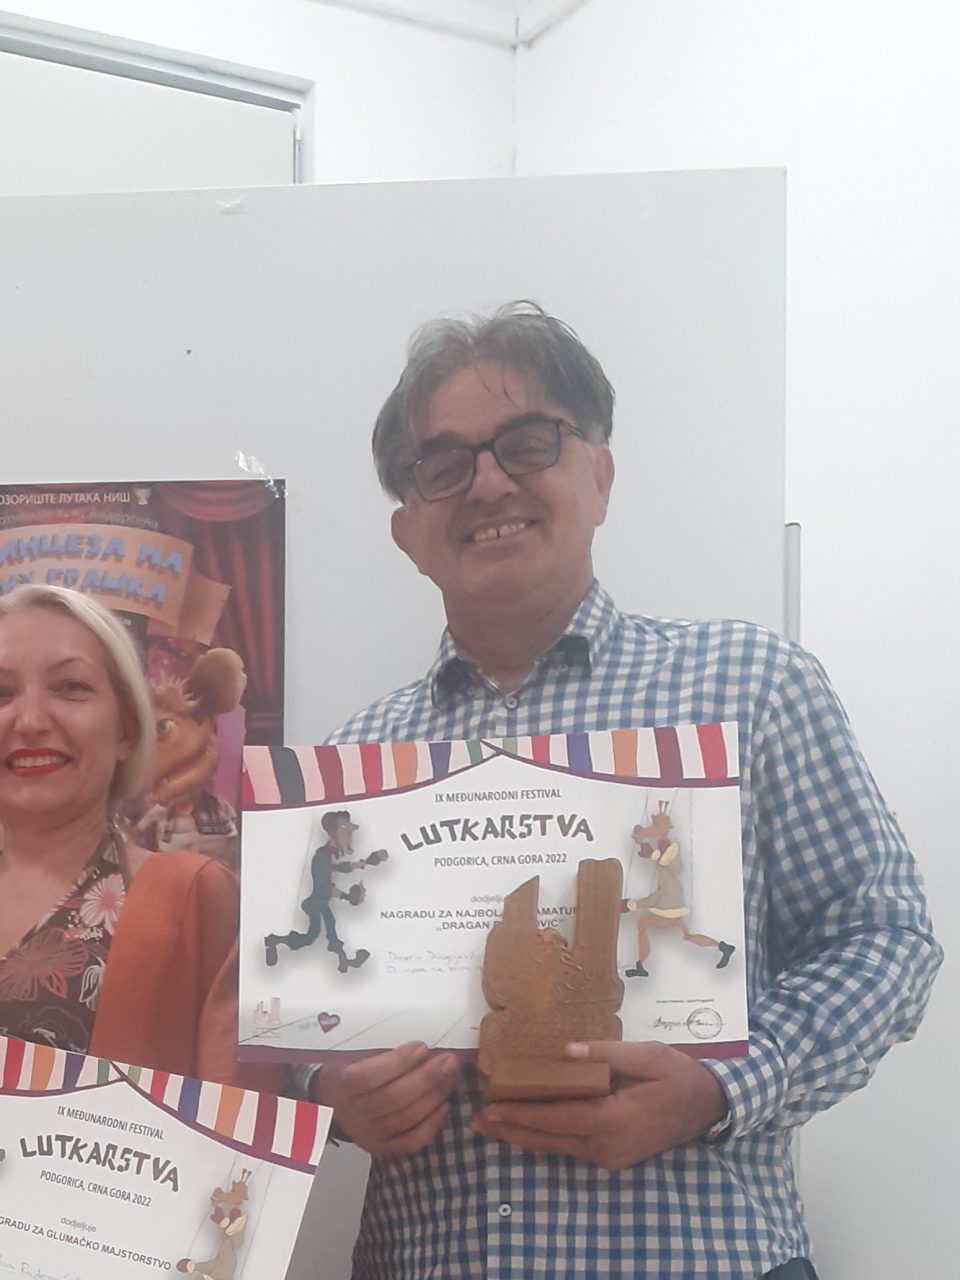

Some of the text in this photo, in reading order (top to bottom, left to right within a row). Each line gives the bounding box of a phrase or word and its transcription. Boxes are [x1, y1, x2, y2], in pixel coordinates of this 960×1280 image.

[58, 492, 101, 504] ЛУТАКА
[103, 492, 130, 503] НИШ
[137, 543, 183, 575] НА
[435, 788, 562, 803] IX MEĐUNARODNI FESTIVAL
[401, 813, 594, 851] LUTKARSTVA
[434, 853, 568, 868] PODGORICA, CRNA GORA 2022
[380, 910, 435, 919] NAGRADU
[438, 909, 453, 918] ZA
[57, 1105, 165, 1140] IX MEĐUNARODNI FESTIVAL
[19, 1134, 179, 1193] LUTKARSTVA
[40, 1169, 152, 1207] PODGORICA, CRNA GORA 2022
[60, 1216, 97, 1233] dodjeljuje
[31, 1225, 44, 1236] ZA
[46, 1229, 100, 1251] GLUMAČKO
[101, 1244, 172, 1271] MAJSTORSTVO
